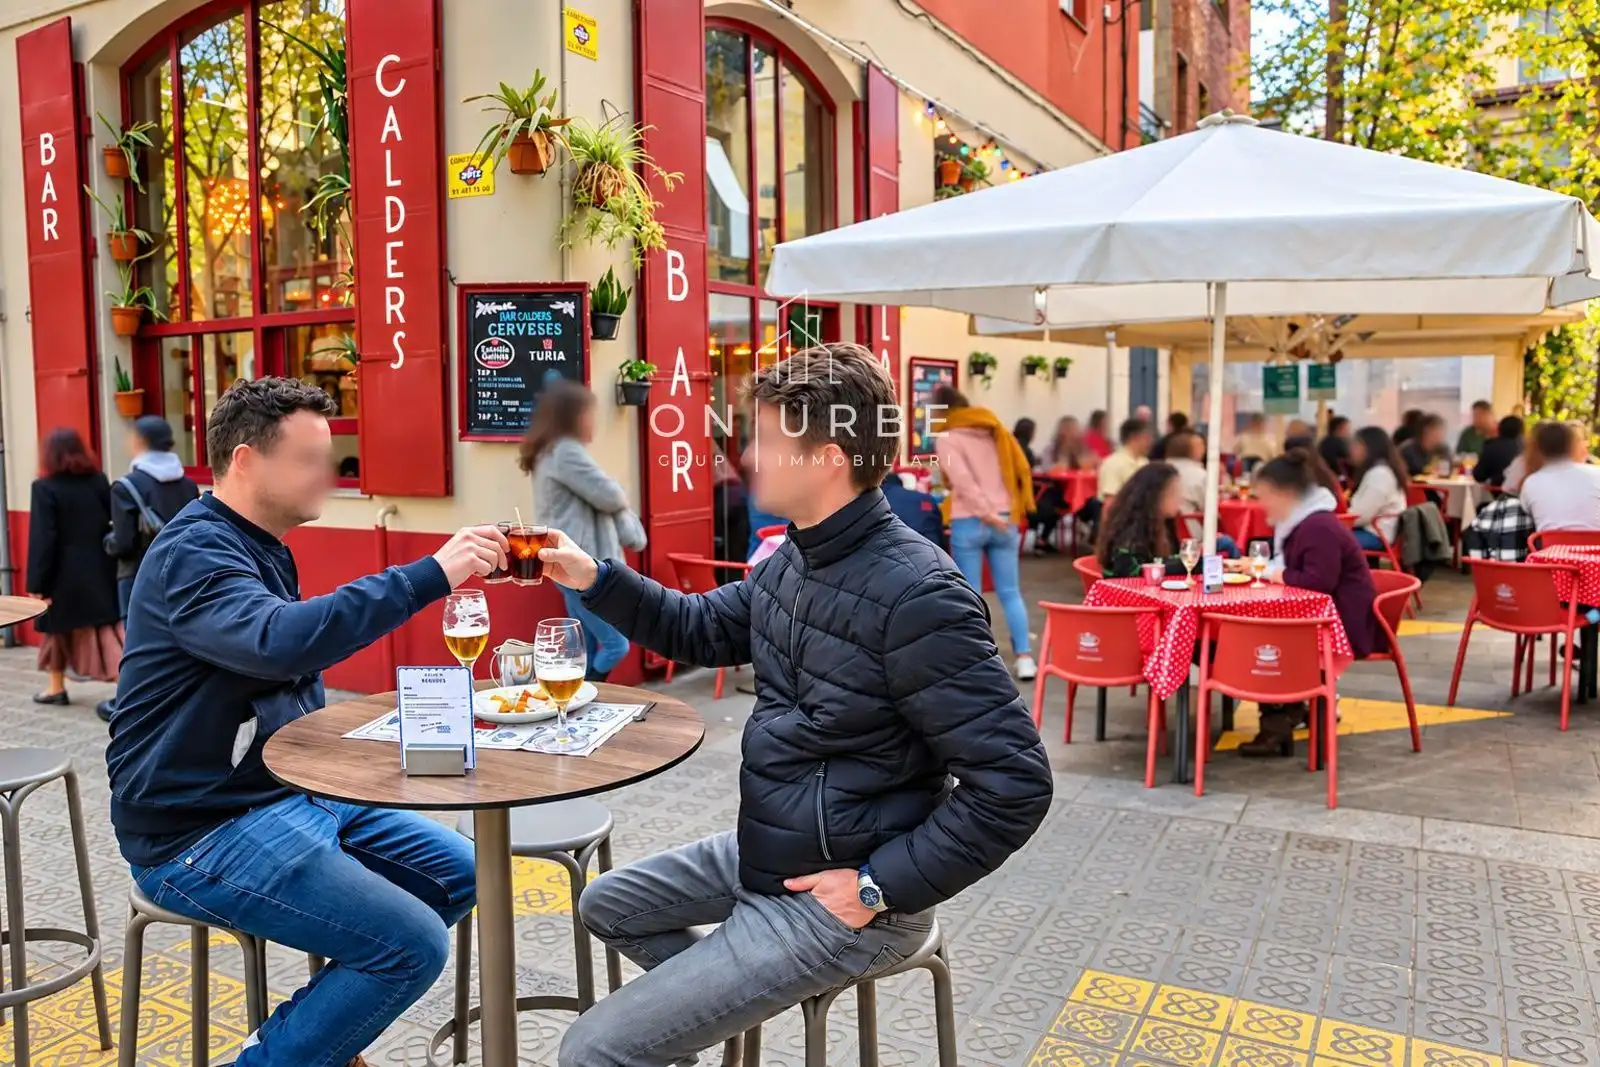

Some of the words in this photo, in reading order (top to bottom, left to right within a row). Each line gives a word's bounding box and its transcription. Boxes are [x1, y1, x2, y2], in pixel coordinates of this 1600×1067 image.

[39, 132, 59, 241] BAR
[375, 54, 407, 370] CALDERS
[487, 322, 563, 336] CERVESES
[499, 311, 516, 322] BAR
[517, 311, 552, 321] CALDERS
[529, 350, 566, 361] TURIA
[667, 249, 695, 493] BAR
